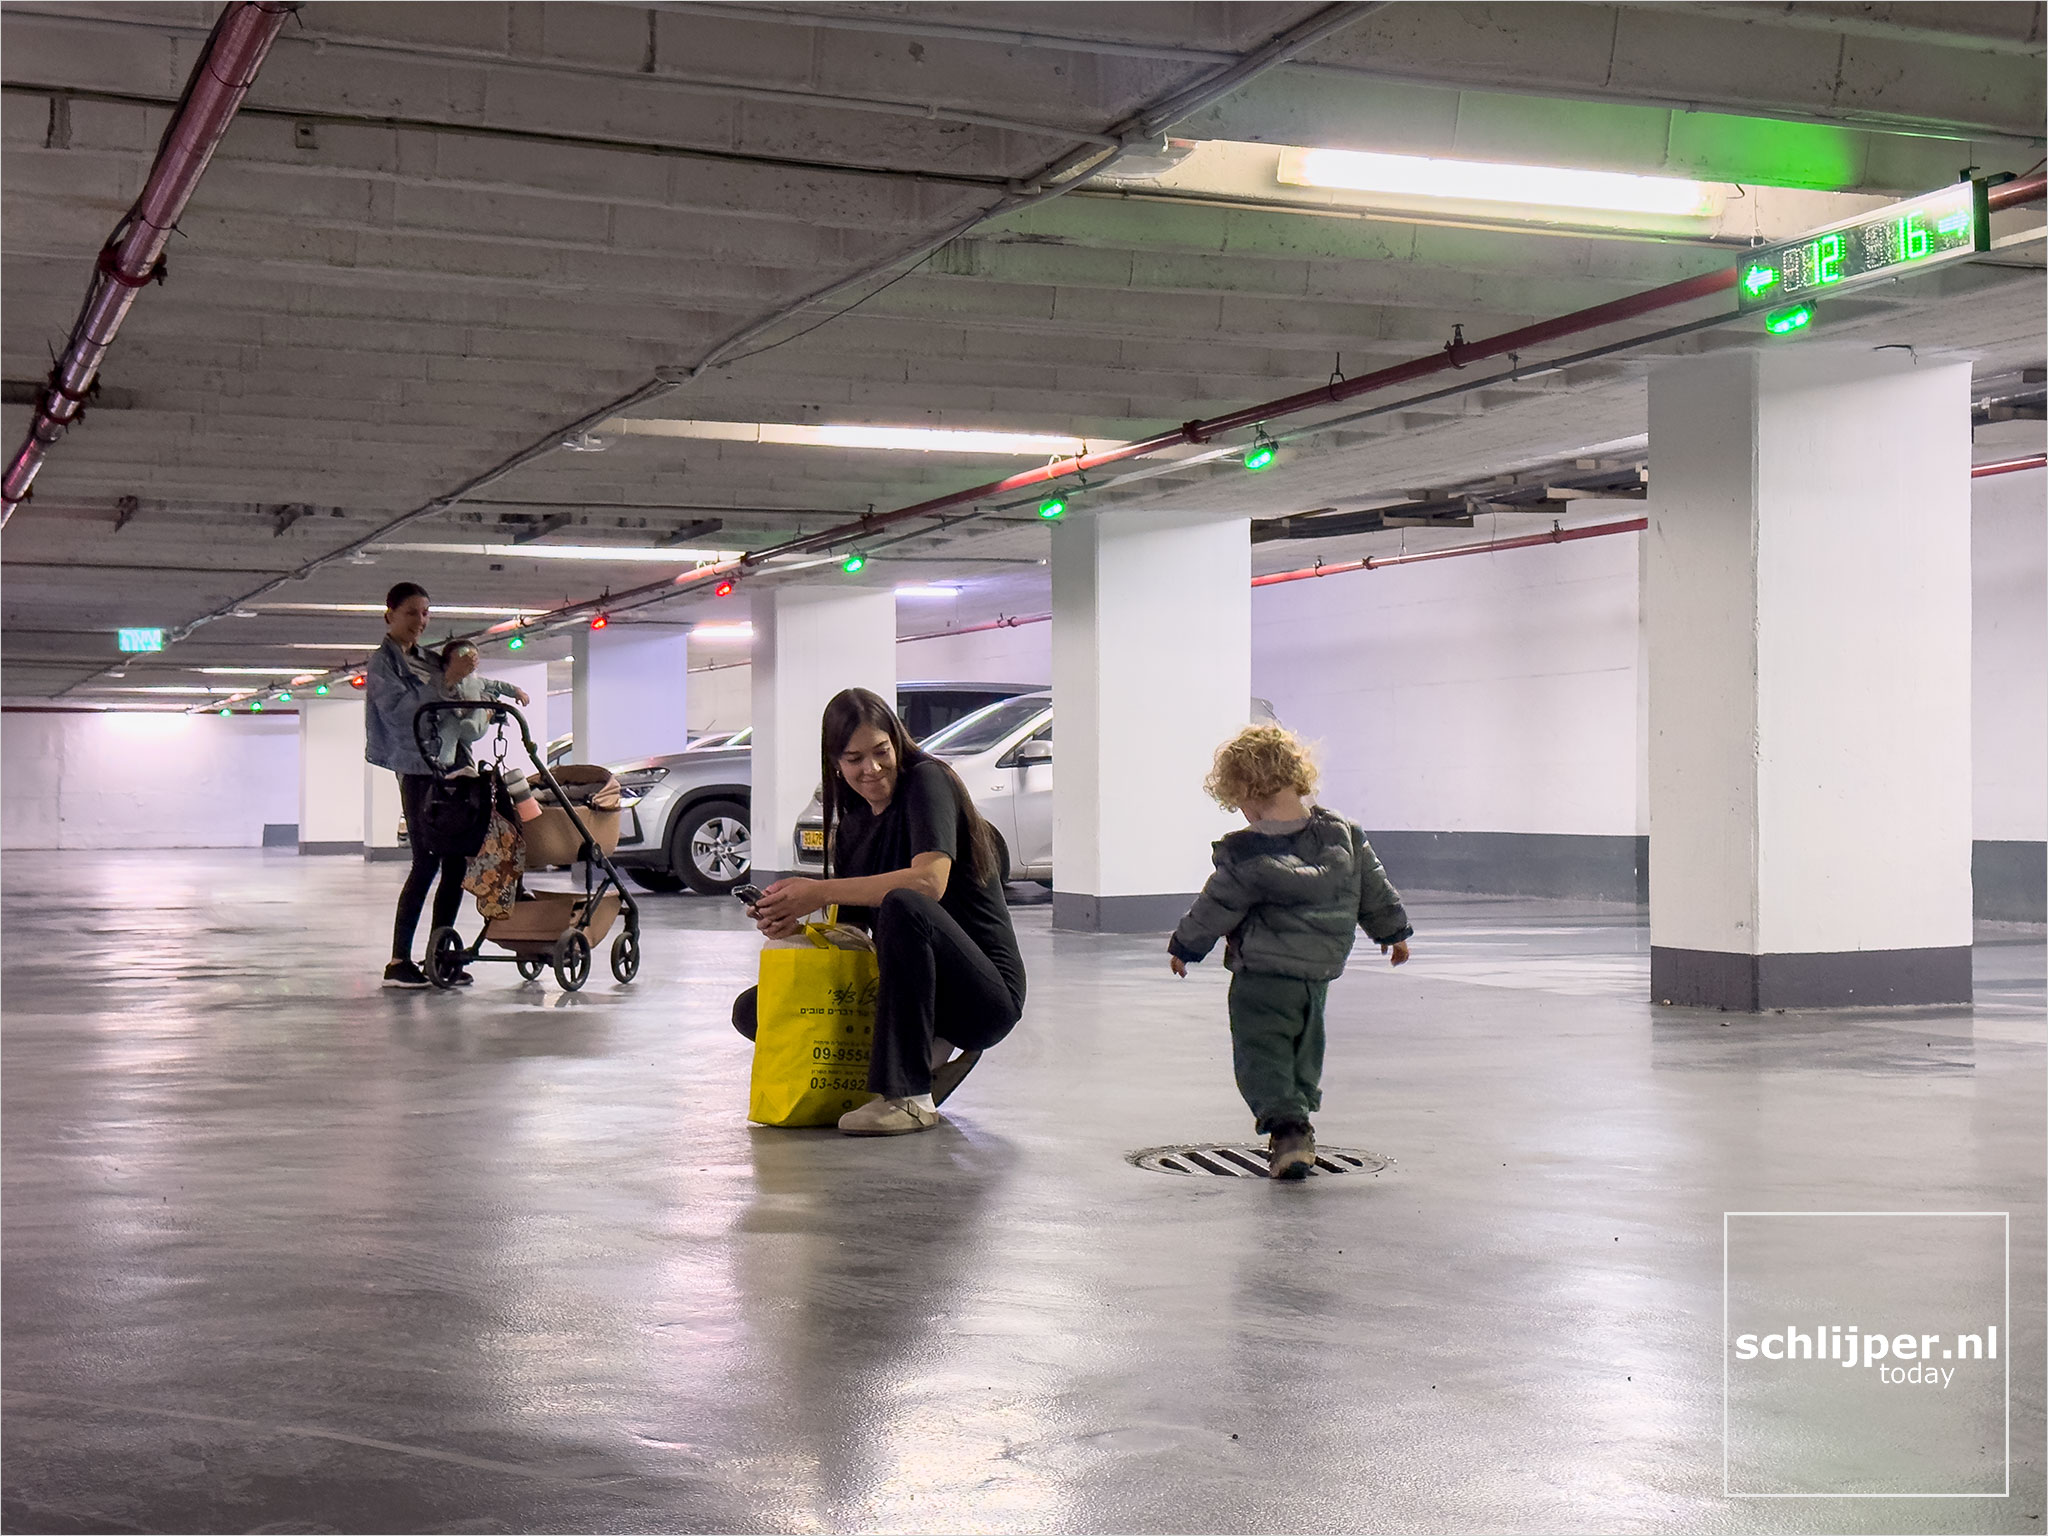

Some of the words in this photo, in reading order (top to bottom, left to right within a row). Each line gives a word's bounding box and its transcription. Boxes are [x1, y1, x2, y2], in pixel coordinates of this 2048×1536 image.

[1811, 234, 1843, 286] 12
[1898, 210, 1930, 261] 16
[810, 1077, 866, 1091] 03-5492
